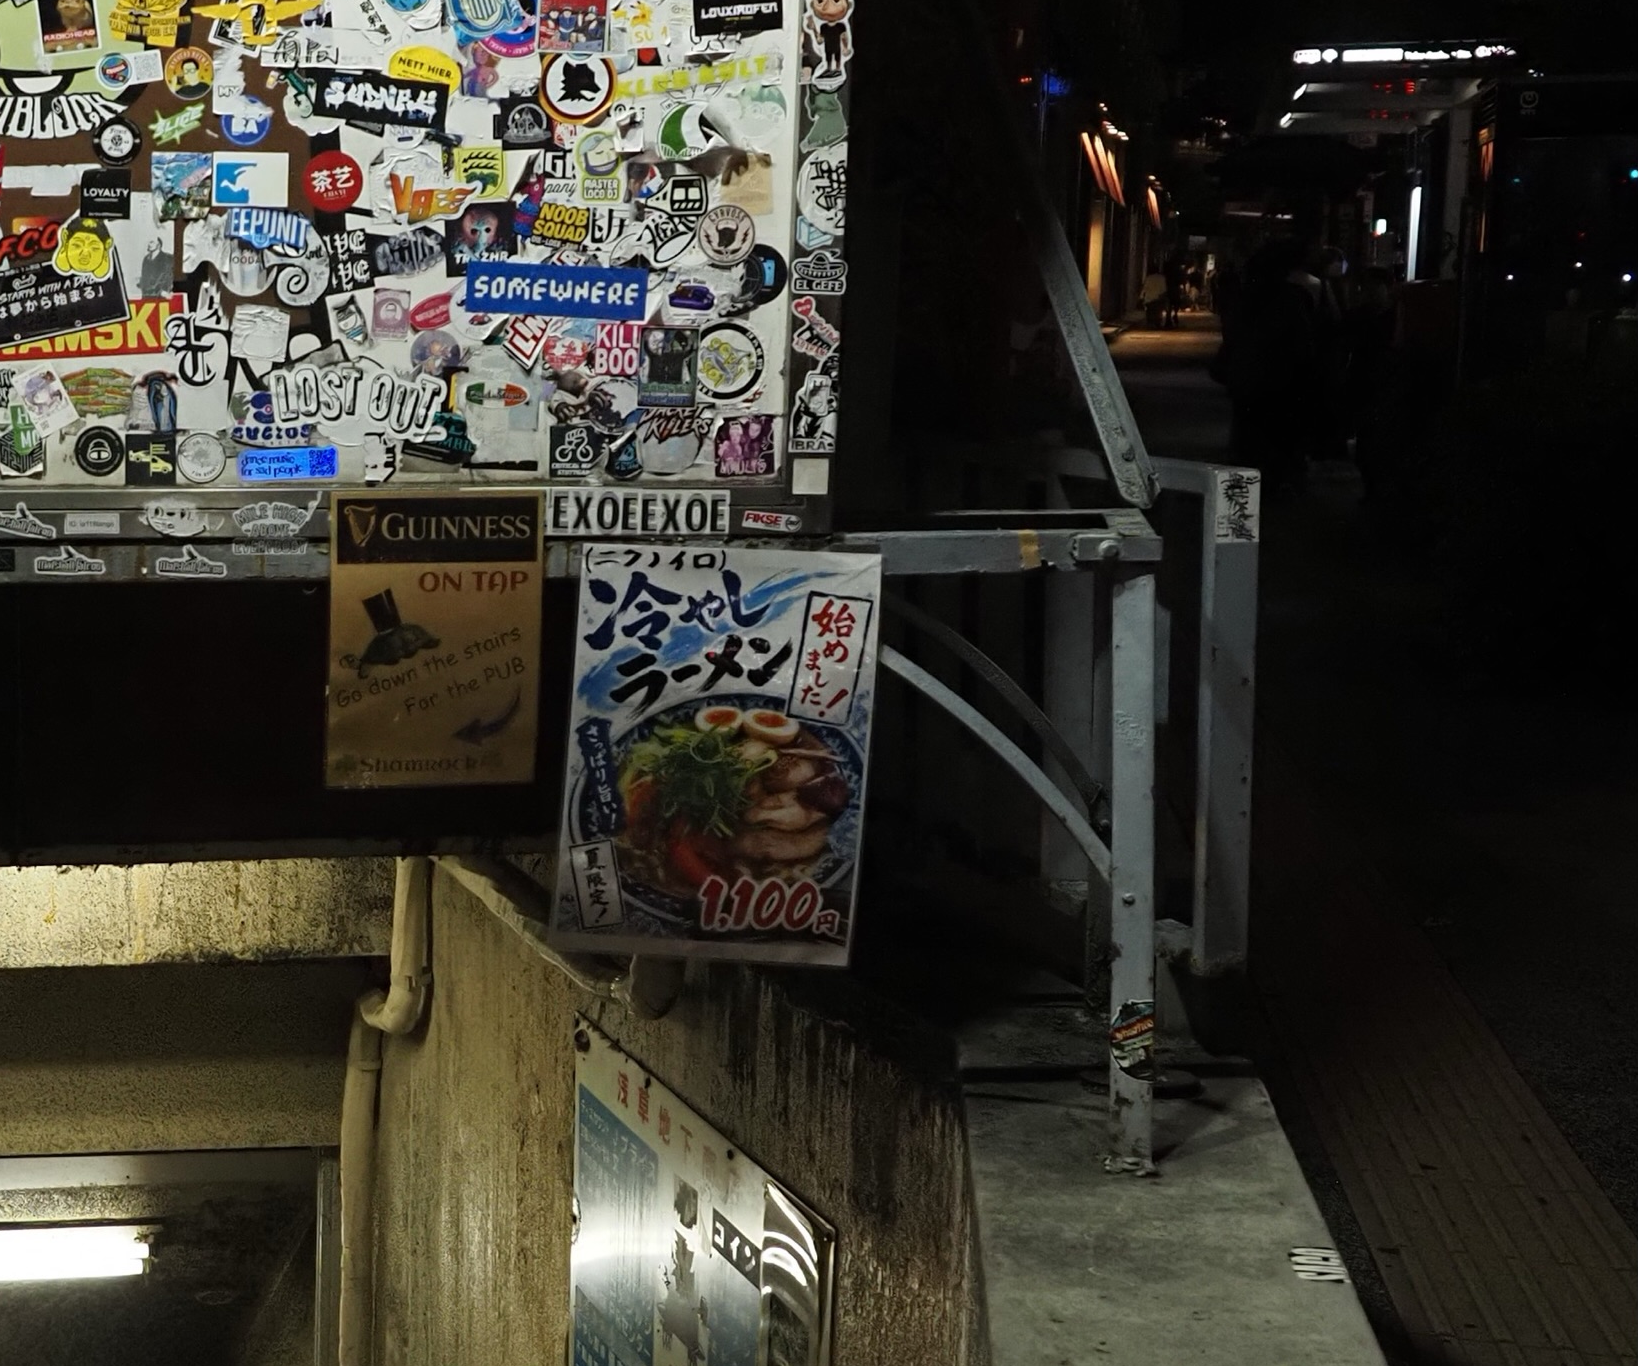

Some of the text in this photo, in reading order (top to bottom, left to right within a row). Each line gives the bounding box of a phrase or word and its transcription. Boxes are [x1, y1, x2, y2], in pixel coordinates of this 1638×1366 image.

[43, 29, 96, 44] RADIOHEAD
[397, 56, 425, 72] NETT
[311, 164, 356, 194] 茶艺
[583, 178, 619, 191] MASTER
[83, 186, 130, 199] LOYALTY
[583, 189, 605, 200] LOCO
[538, 203, 590, 229] NOOB
[531, 220, 588, 245] SQUAD
[33, 285, 61, 301] WITH
[473, 274, 640, 307] SOMEWHERE
[795, 278, 844, 292] EL GEFE
[274, 364, 445, 434] LOST OUT
[235, 503, 308, 524] MILE HIGH
[552, 492, 728, 534] EXOEEXOE
[744, 511, 782, 526] FIKSE
[250, 524, 290, 537] ABOVE
[380, 512, 531, 542] GUINNESS
[233, 538, 308, 555] EVERYBODY
[418, 569, 530, 595] ON TAP
[583, 569, 771, 651] 冷やし
[336, 626, 522, 709] Go down the stairs
[609, 634, 794, 724] ラーメン
[403, 656, 526, 716] For the PUB
[359, 755, 479, 775] Shamrock
